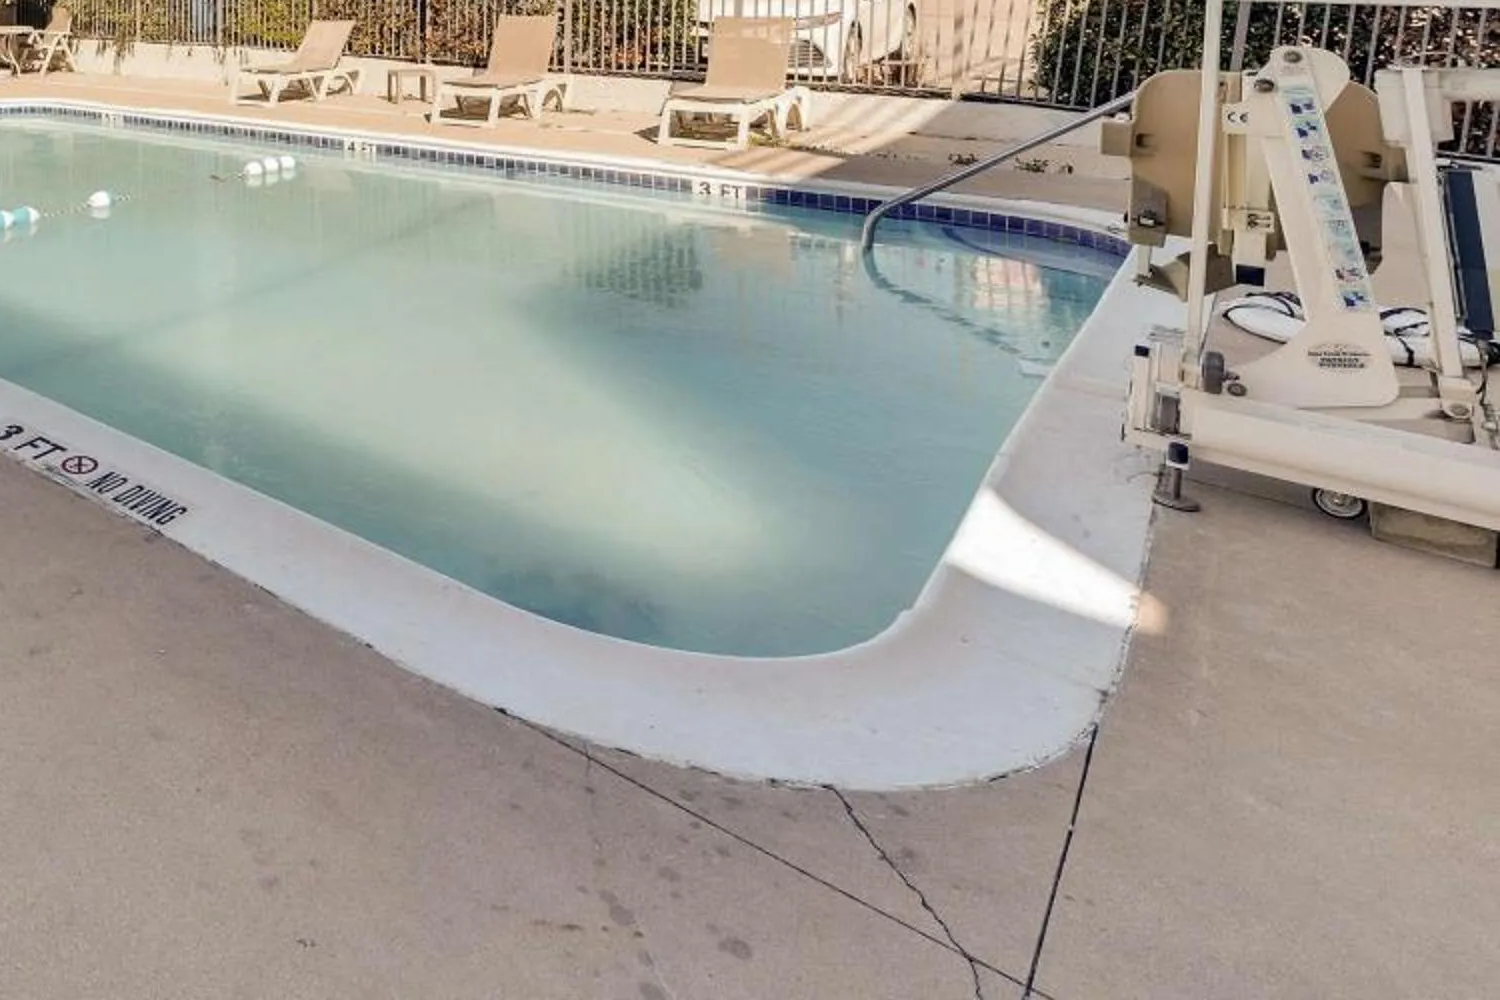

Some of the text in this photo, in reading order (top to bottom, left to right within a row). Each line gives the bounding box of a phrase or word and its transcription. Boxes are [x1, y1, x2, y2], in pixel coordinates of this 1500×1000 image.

[699, 181, 742, 199] 3 FT
[14, 436, 68, 460] FT
[85, 471, 128, 494] NO
[112, 485, 188, 525] DIVING
